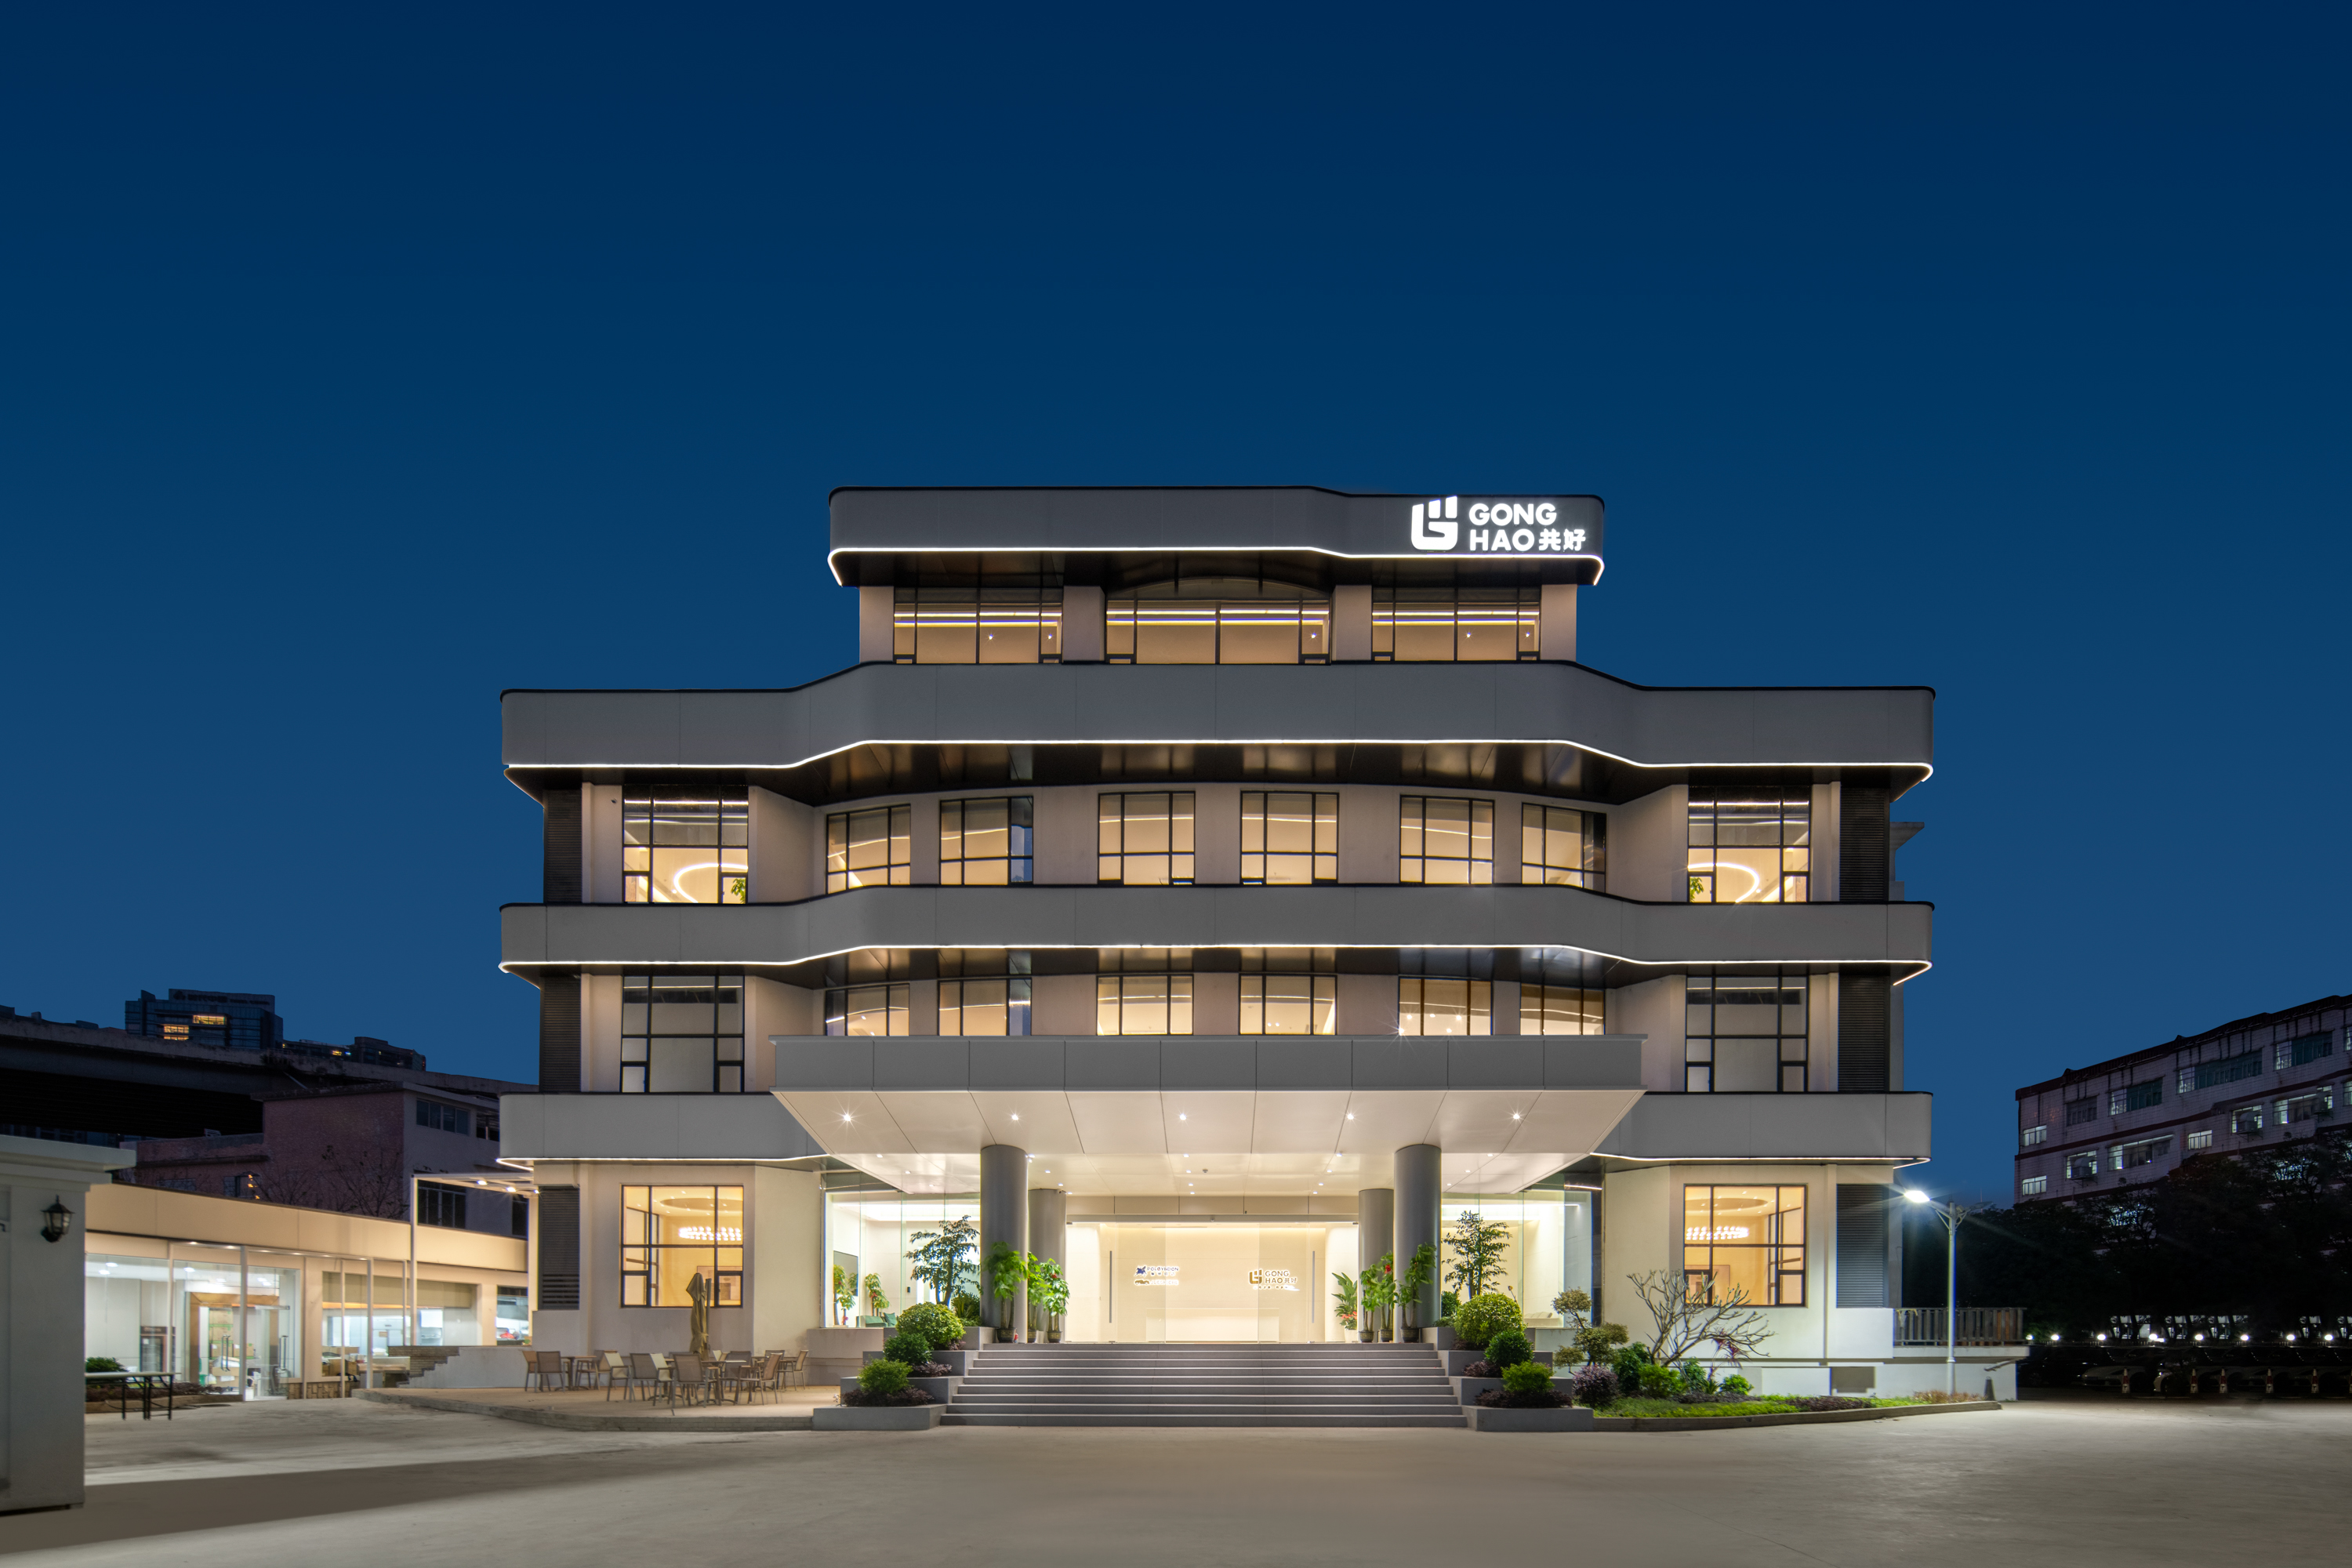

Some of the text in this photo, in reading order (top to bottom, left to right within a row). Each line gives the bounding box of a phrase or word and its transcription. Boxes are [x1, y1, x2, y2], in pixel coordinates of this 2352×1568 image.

[1468, 503, 1557, 526] GONG
[1469, 528, 1586, 551] HAO 共好
